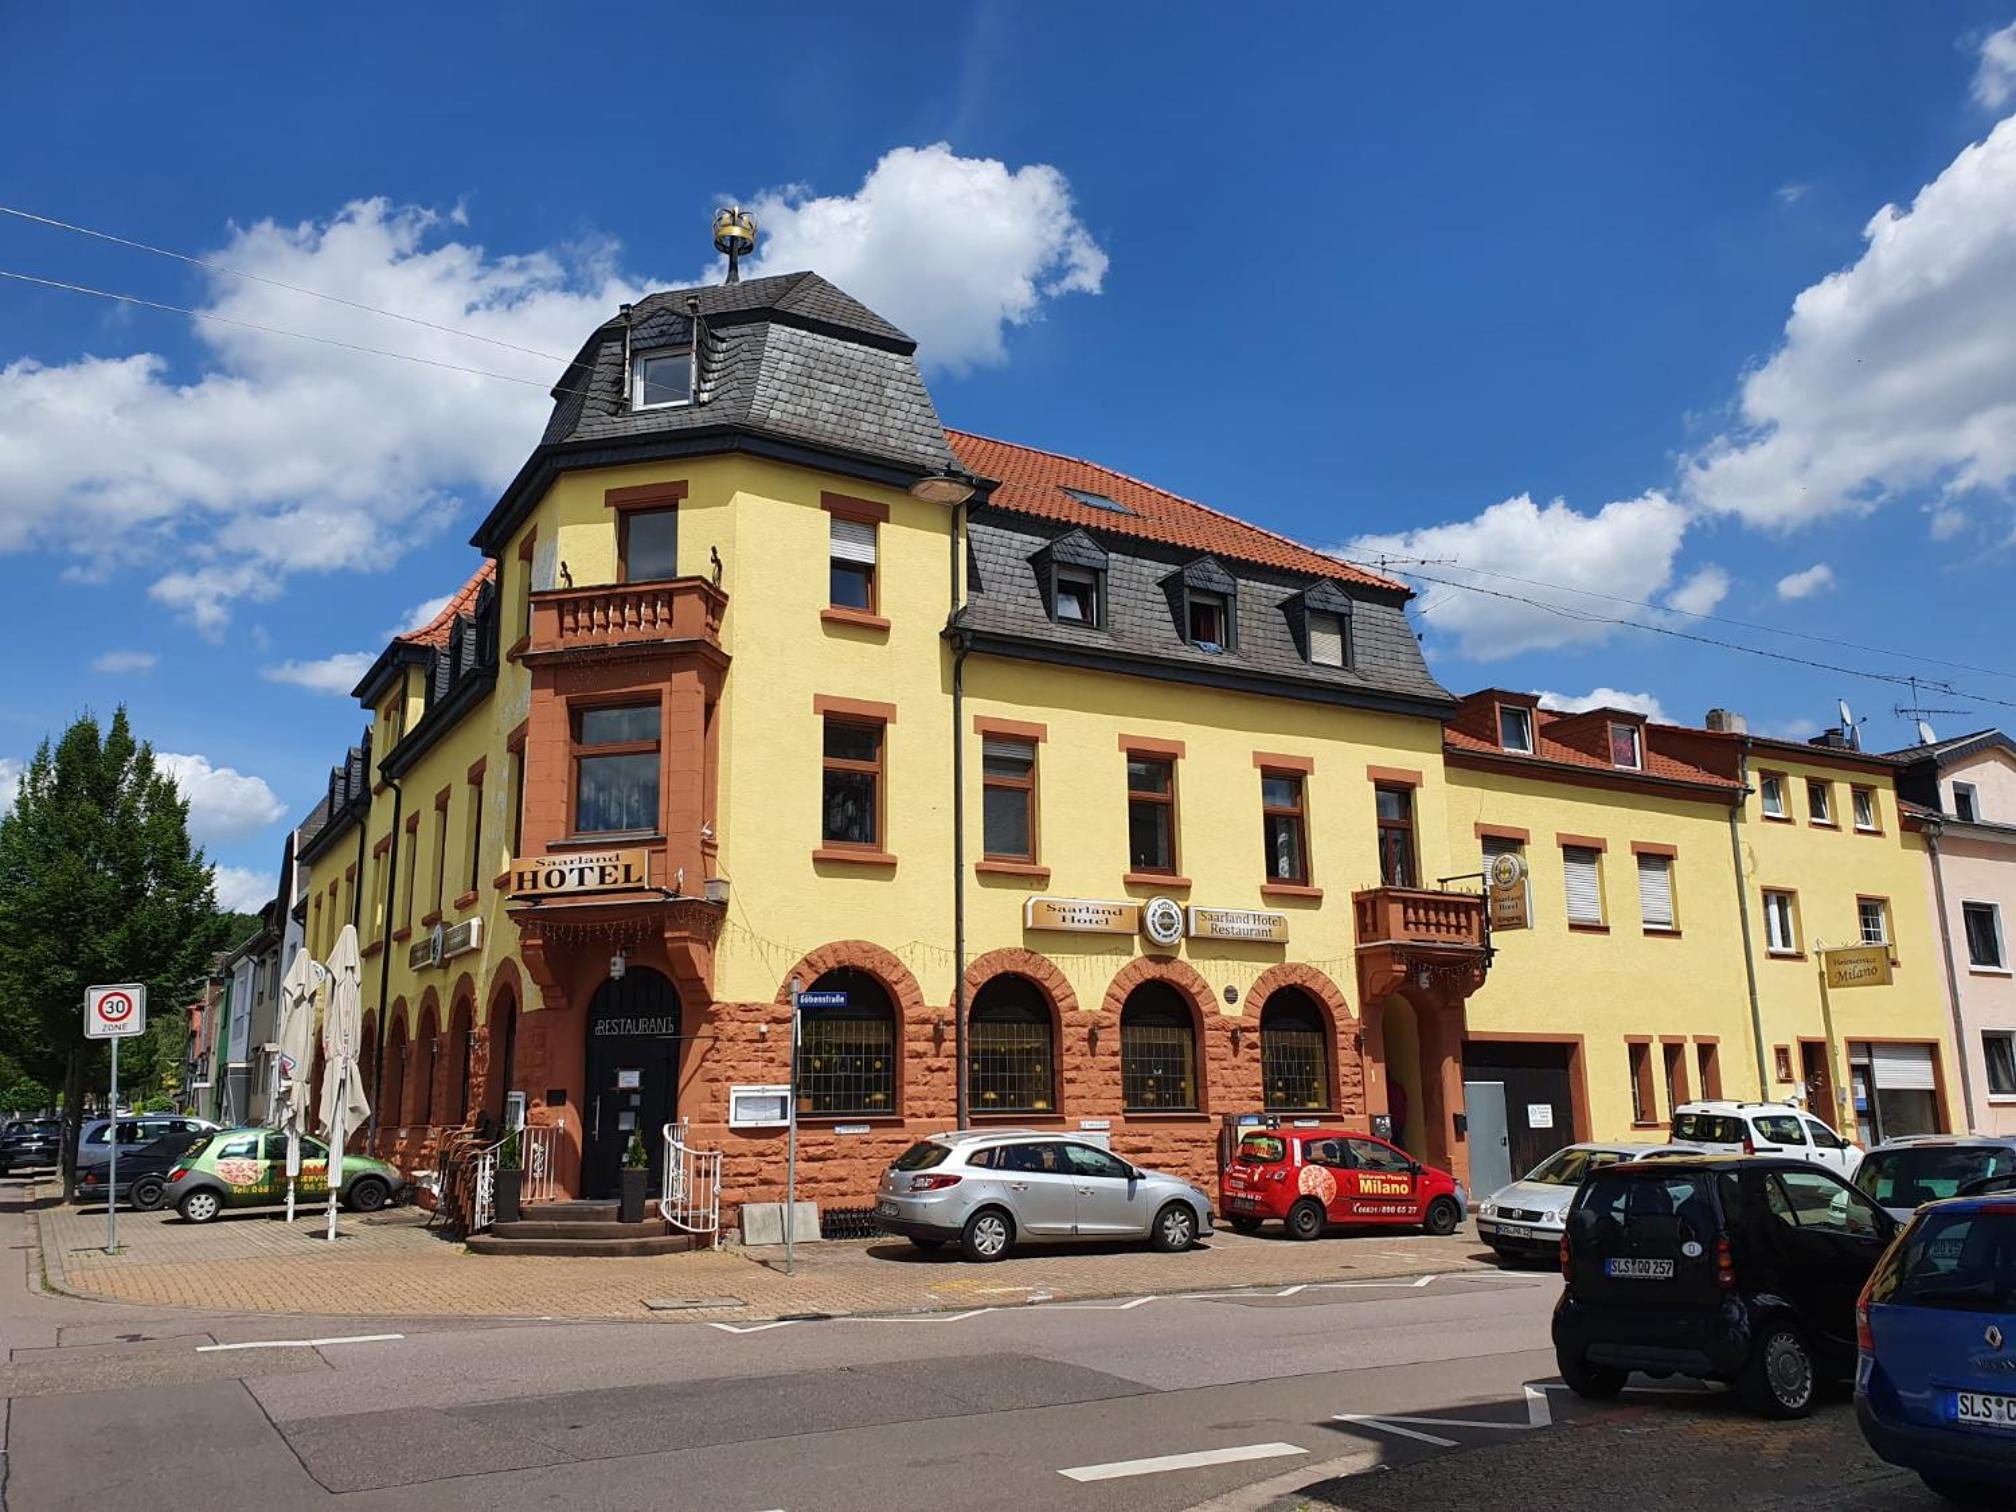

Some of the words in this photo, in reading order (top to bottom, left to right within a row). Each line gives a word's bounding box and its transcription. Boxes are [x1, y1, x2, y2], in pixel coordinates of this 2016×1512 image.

[535, 853, 620, 867] Saarland
[516, 863, 643, 891] HOTEL
[1046, 904, 1123, 917] Saarland
[1061, 915, 1109, 925] Hotel
[1200, 911, 1250, 924] Saarland
[1253, 914, 1282, 927] Hotel
[1210, 923, 1273, 938] Restaurant
[1835, 966, 1878, 984] Milano
[105, 1000, 126, 1014] 30
[102, 1023, 128, 1032] ZONE
[594, 1016, 674, 1036] RESTAURANT
[1360, 1179, 1409, 1194] Milano
[1612, 1260, 1630, 1273] SLS
[1653, 1262, 1673, 1275] 257
[1960, 1395, 1992, 1418] SLS
